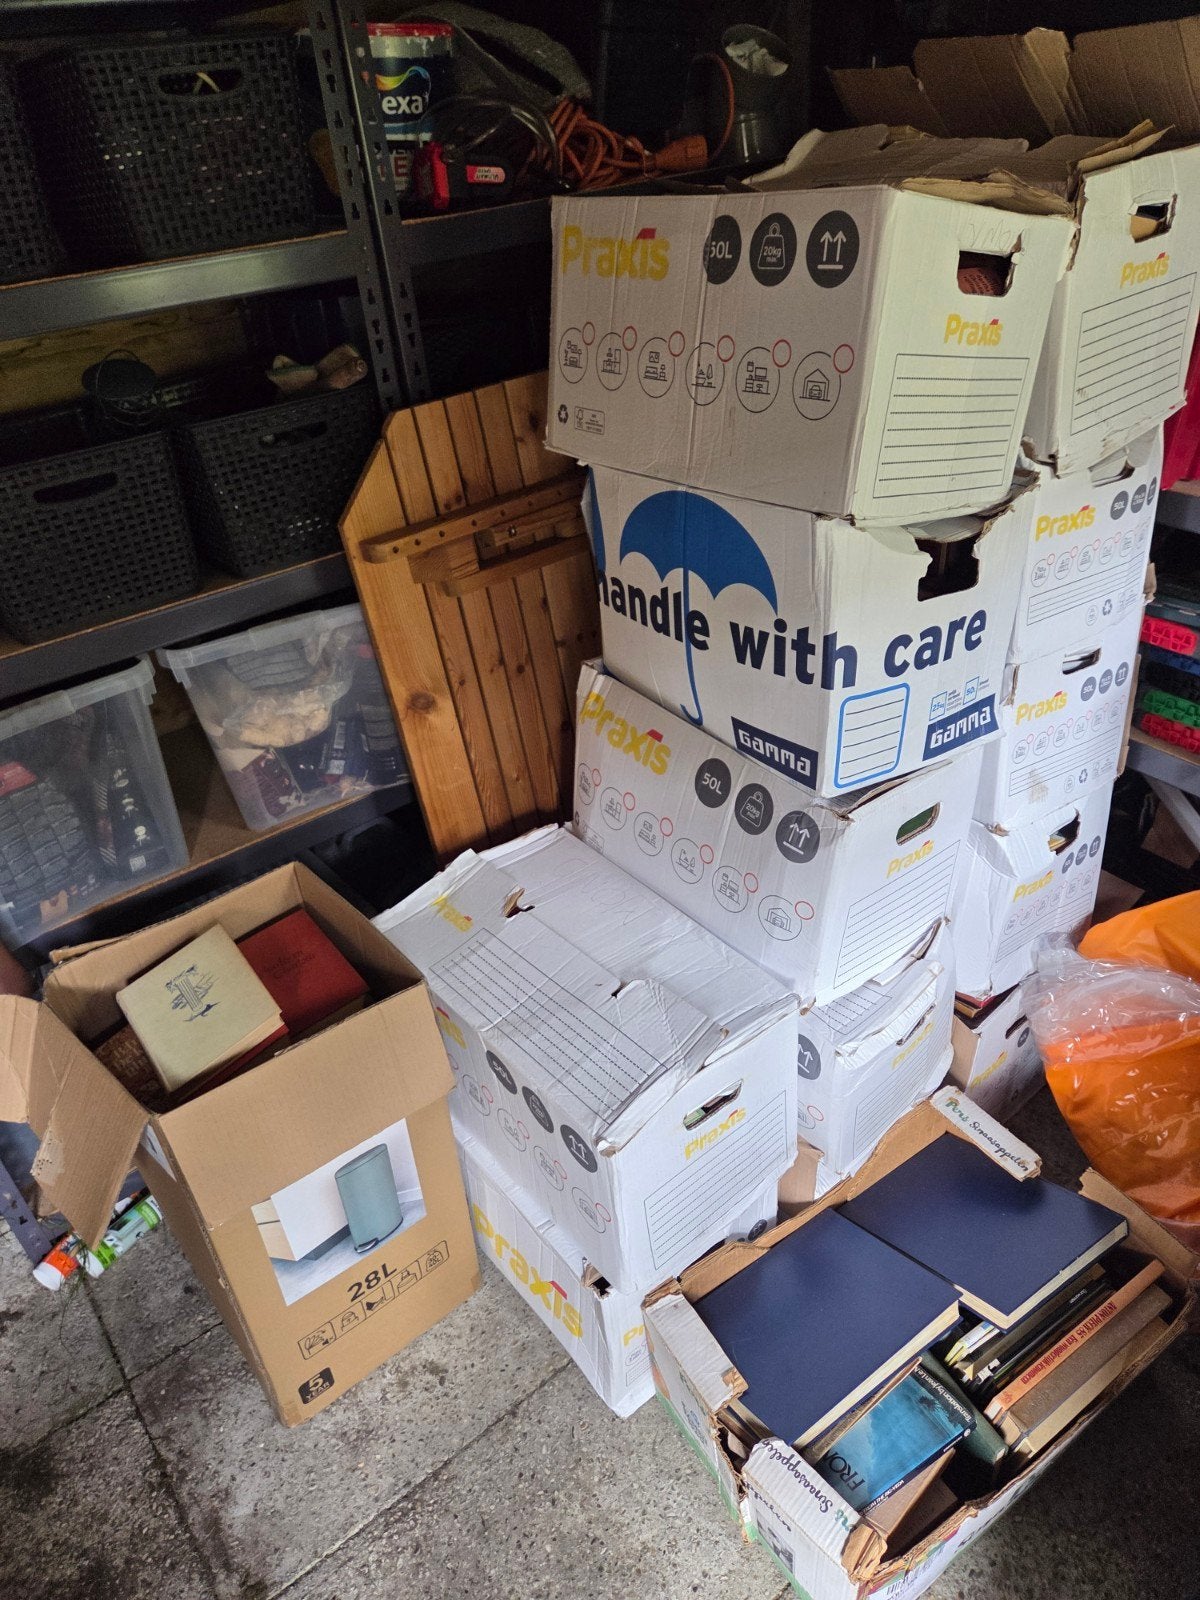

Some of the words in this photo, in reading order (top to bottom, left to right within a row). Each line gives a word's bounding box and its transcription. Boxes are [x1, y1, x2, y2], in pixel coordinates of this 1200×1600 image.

[382, 95, 423, 115] exa
[561, 226, 671, 281] Praxis
[763, 245, 782, 258] 20kg
[1119, 252, 1170, 288] Praxis
[944, 313, 1004, 347] Praxis
[1035, 505, 1096, 541] Praxis
[730, 617, 858, 690] with
[883, 608, 987, 679] care
[930, 705, 991, 749] GAMMA
[1015, 691, 1068, 726] Praxis
[580, 691, 671, 776] Praxis
[738, 728, 812, 777] GAMMA
[702, 772, 723, 796] 50L
[887, 840, 935, 879] Praxis
[891, 1021, 935, 1069] Praxis
[684, 1107, 747, 1160] Praxis
[347, 1263, 397, 1302] 28L
[472, 1203, 583, 1339] Praxis
[306, 1381, 330, 1401] YEAR
[310, 1373, 325, 1390] 5
[934, 1383, 946, 1395] by
[941, 1390, 973, 1423] Translation
[760, 1438, 834, 1514] Sinaasappelen
